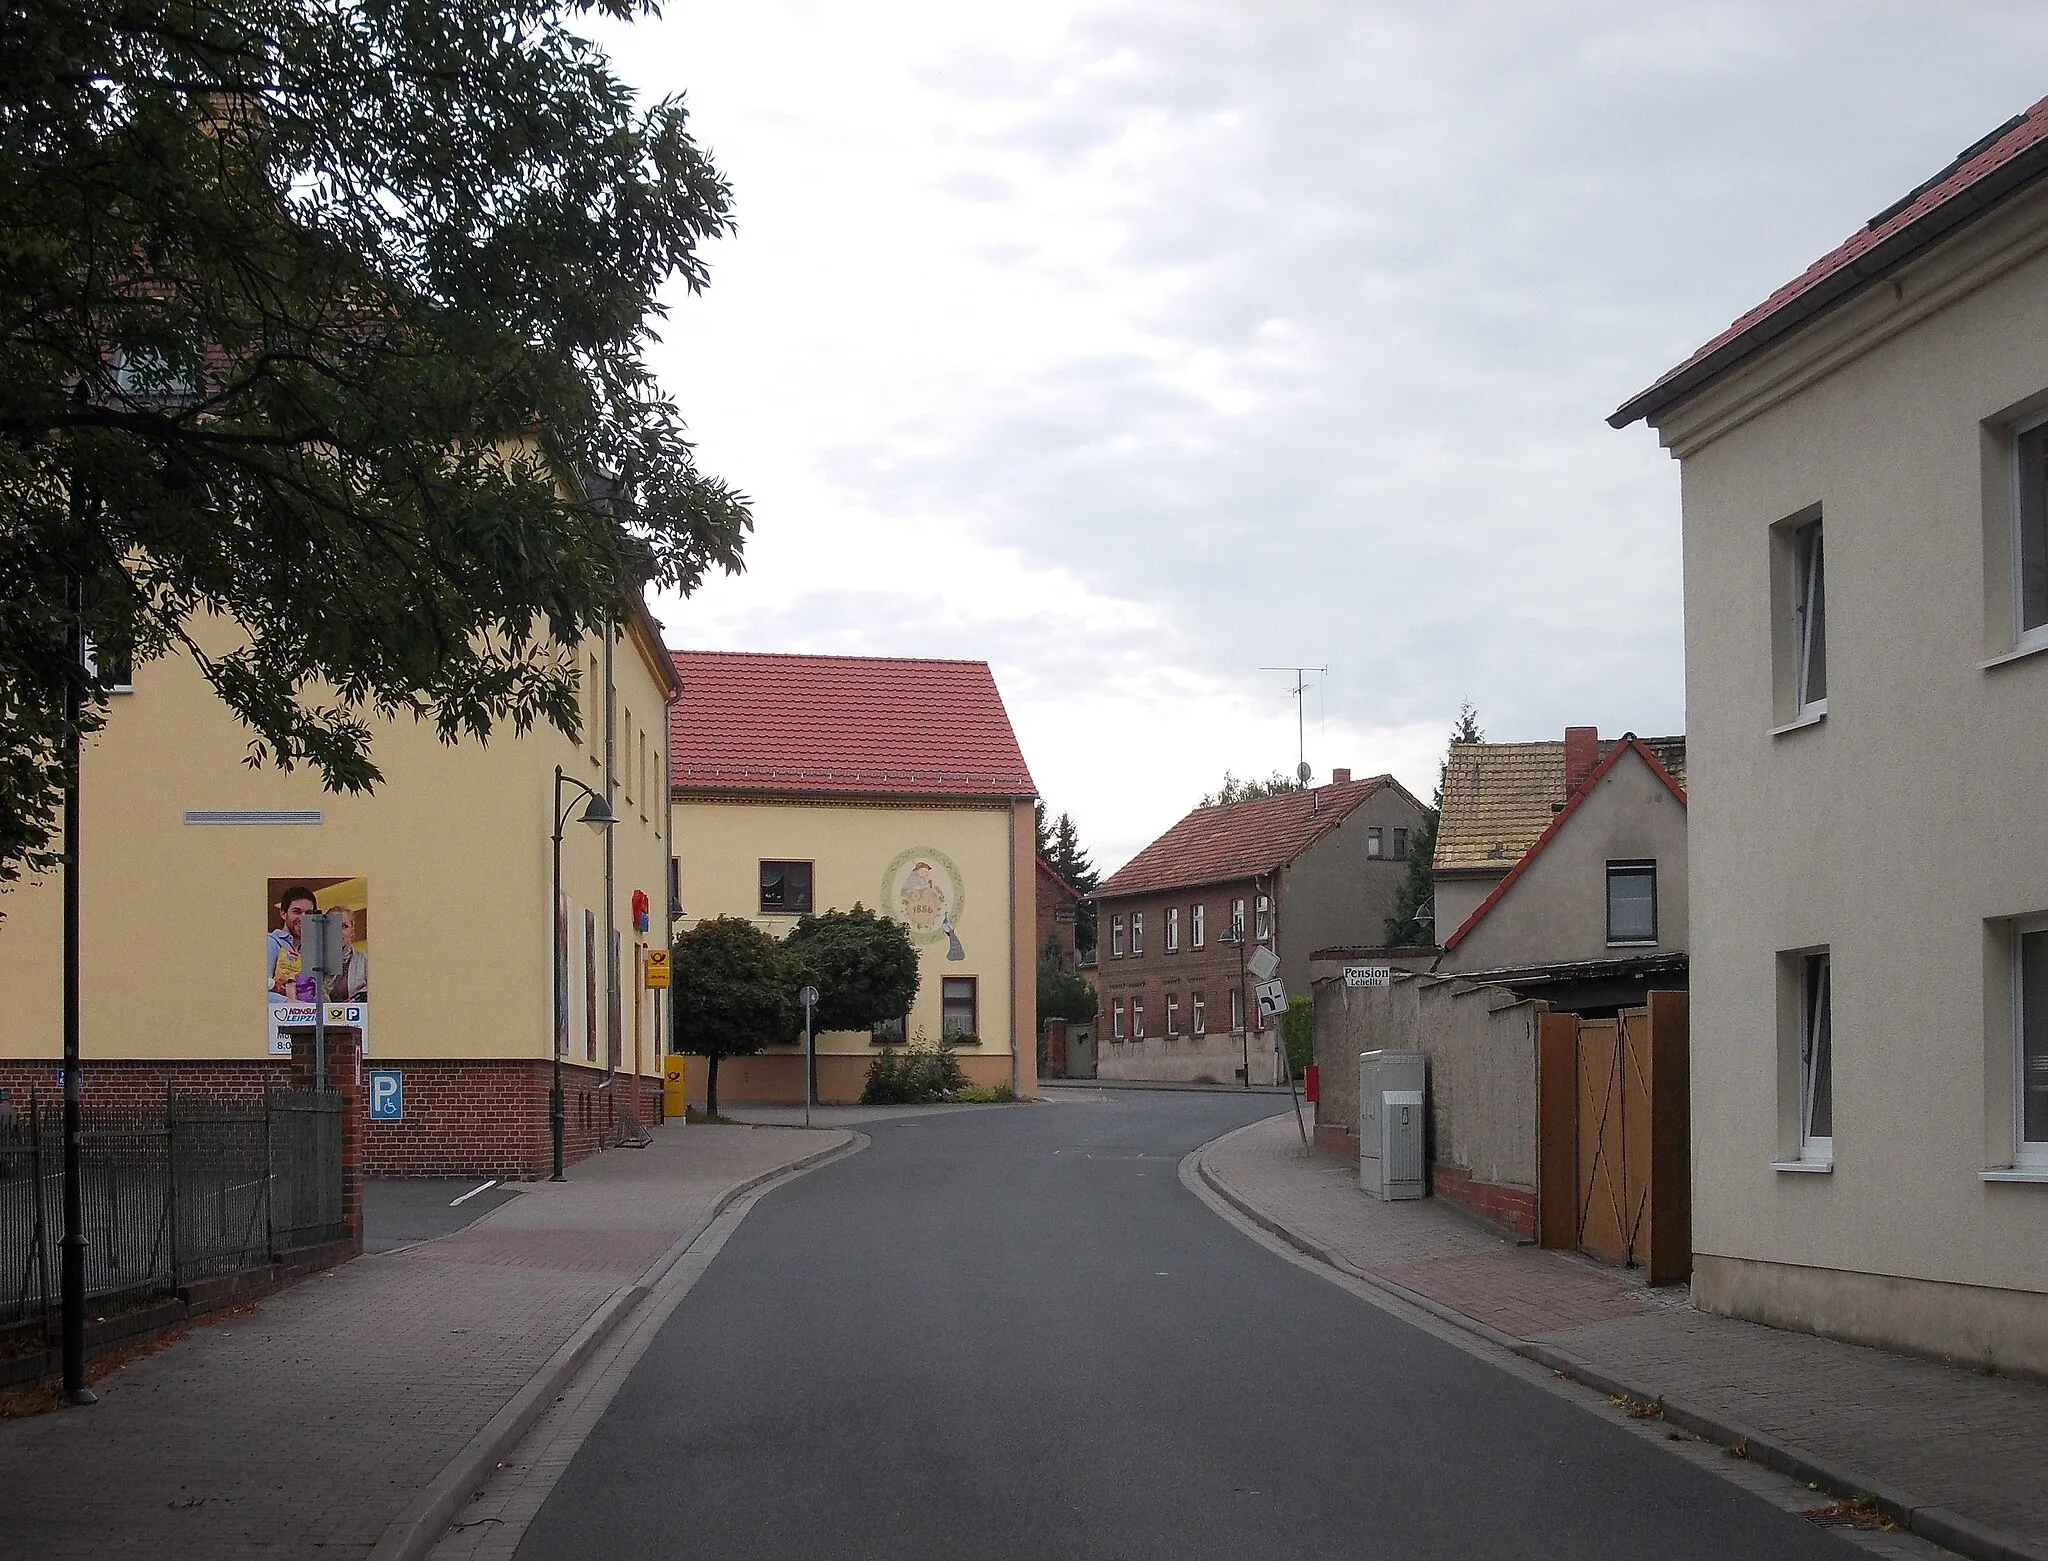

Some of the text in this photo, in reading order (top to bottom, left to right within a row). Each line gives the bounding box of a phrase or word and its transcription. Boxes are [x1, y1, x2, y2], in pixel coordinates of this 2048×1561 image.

[913, 905, 933, 913] 1886
[1345, 968, 1388, 978] Pension
[375, 1076, 397, 1111] P
